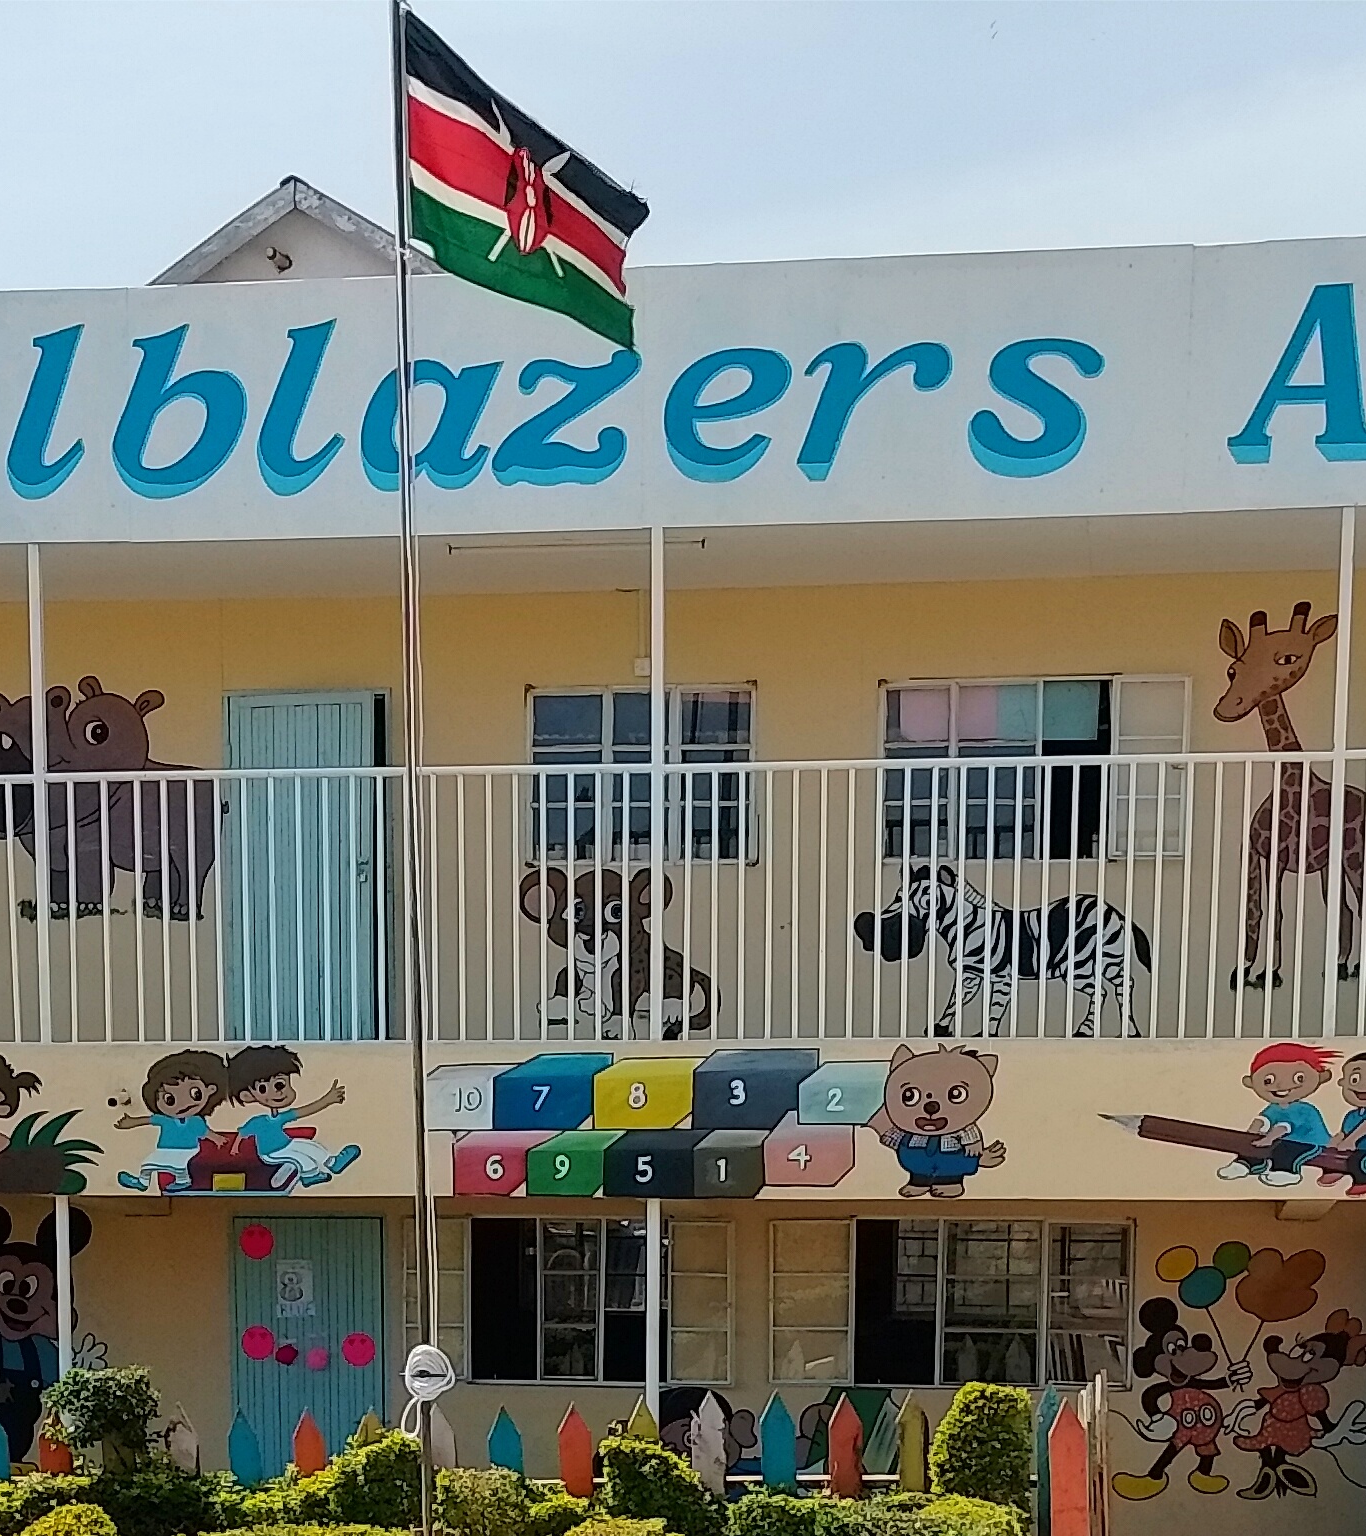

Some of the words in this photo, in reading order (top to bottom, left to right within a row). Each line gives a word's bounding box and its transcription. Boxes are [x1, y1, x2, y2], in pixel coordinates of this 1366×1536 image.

[452, 1085, 483, 1113] 10
[531, 1084, 552, 1112] 7
[627, 1081, 648, 1110] 8
[728, 1078, 747, 1107] 3
[825, 1087, 845, 1113] 2
[485, 1153, 505, 1181] 6
[553, 1153, 571, 1181] 9
[634, 1154, 654, 1184] 5
[715, 1157, 728, 1184] 1
[786, 1143, 812, 1171] 4
